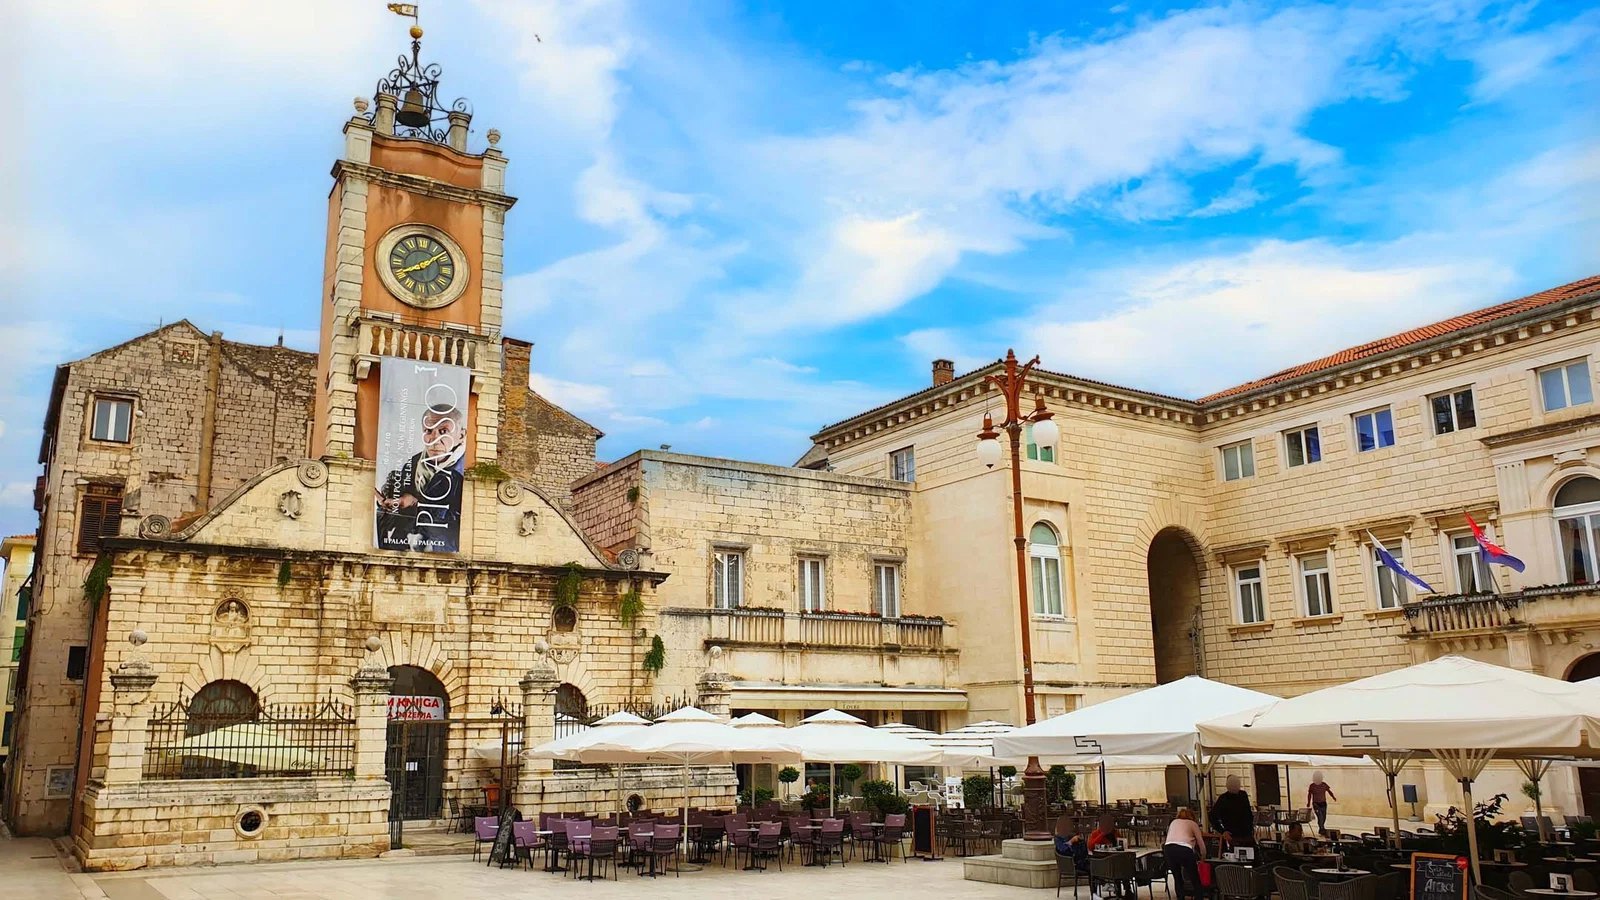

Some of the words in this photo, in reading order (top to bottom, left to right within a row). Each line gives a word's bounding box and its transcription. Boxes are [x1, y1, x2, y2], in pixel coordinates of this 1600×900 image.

[392, 494, 400, 514] NOVI
[398, 388, 408, 432] BEGINNINGS
[406, 418, 416, 454] Collection
[416, 383, 458, 529] PICASSO
[398, 698, 439, 708] KNIGA
